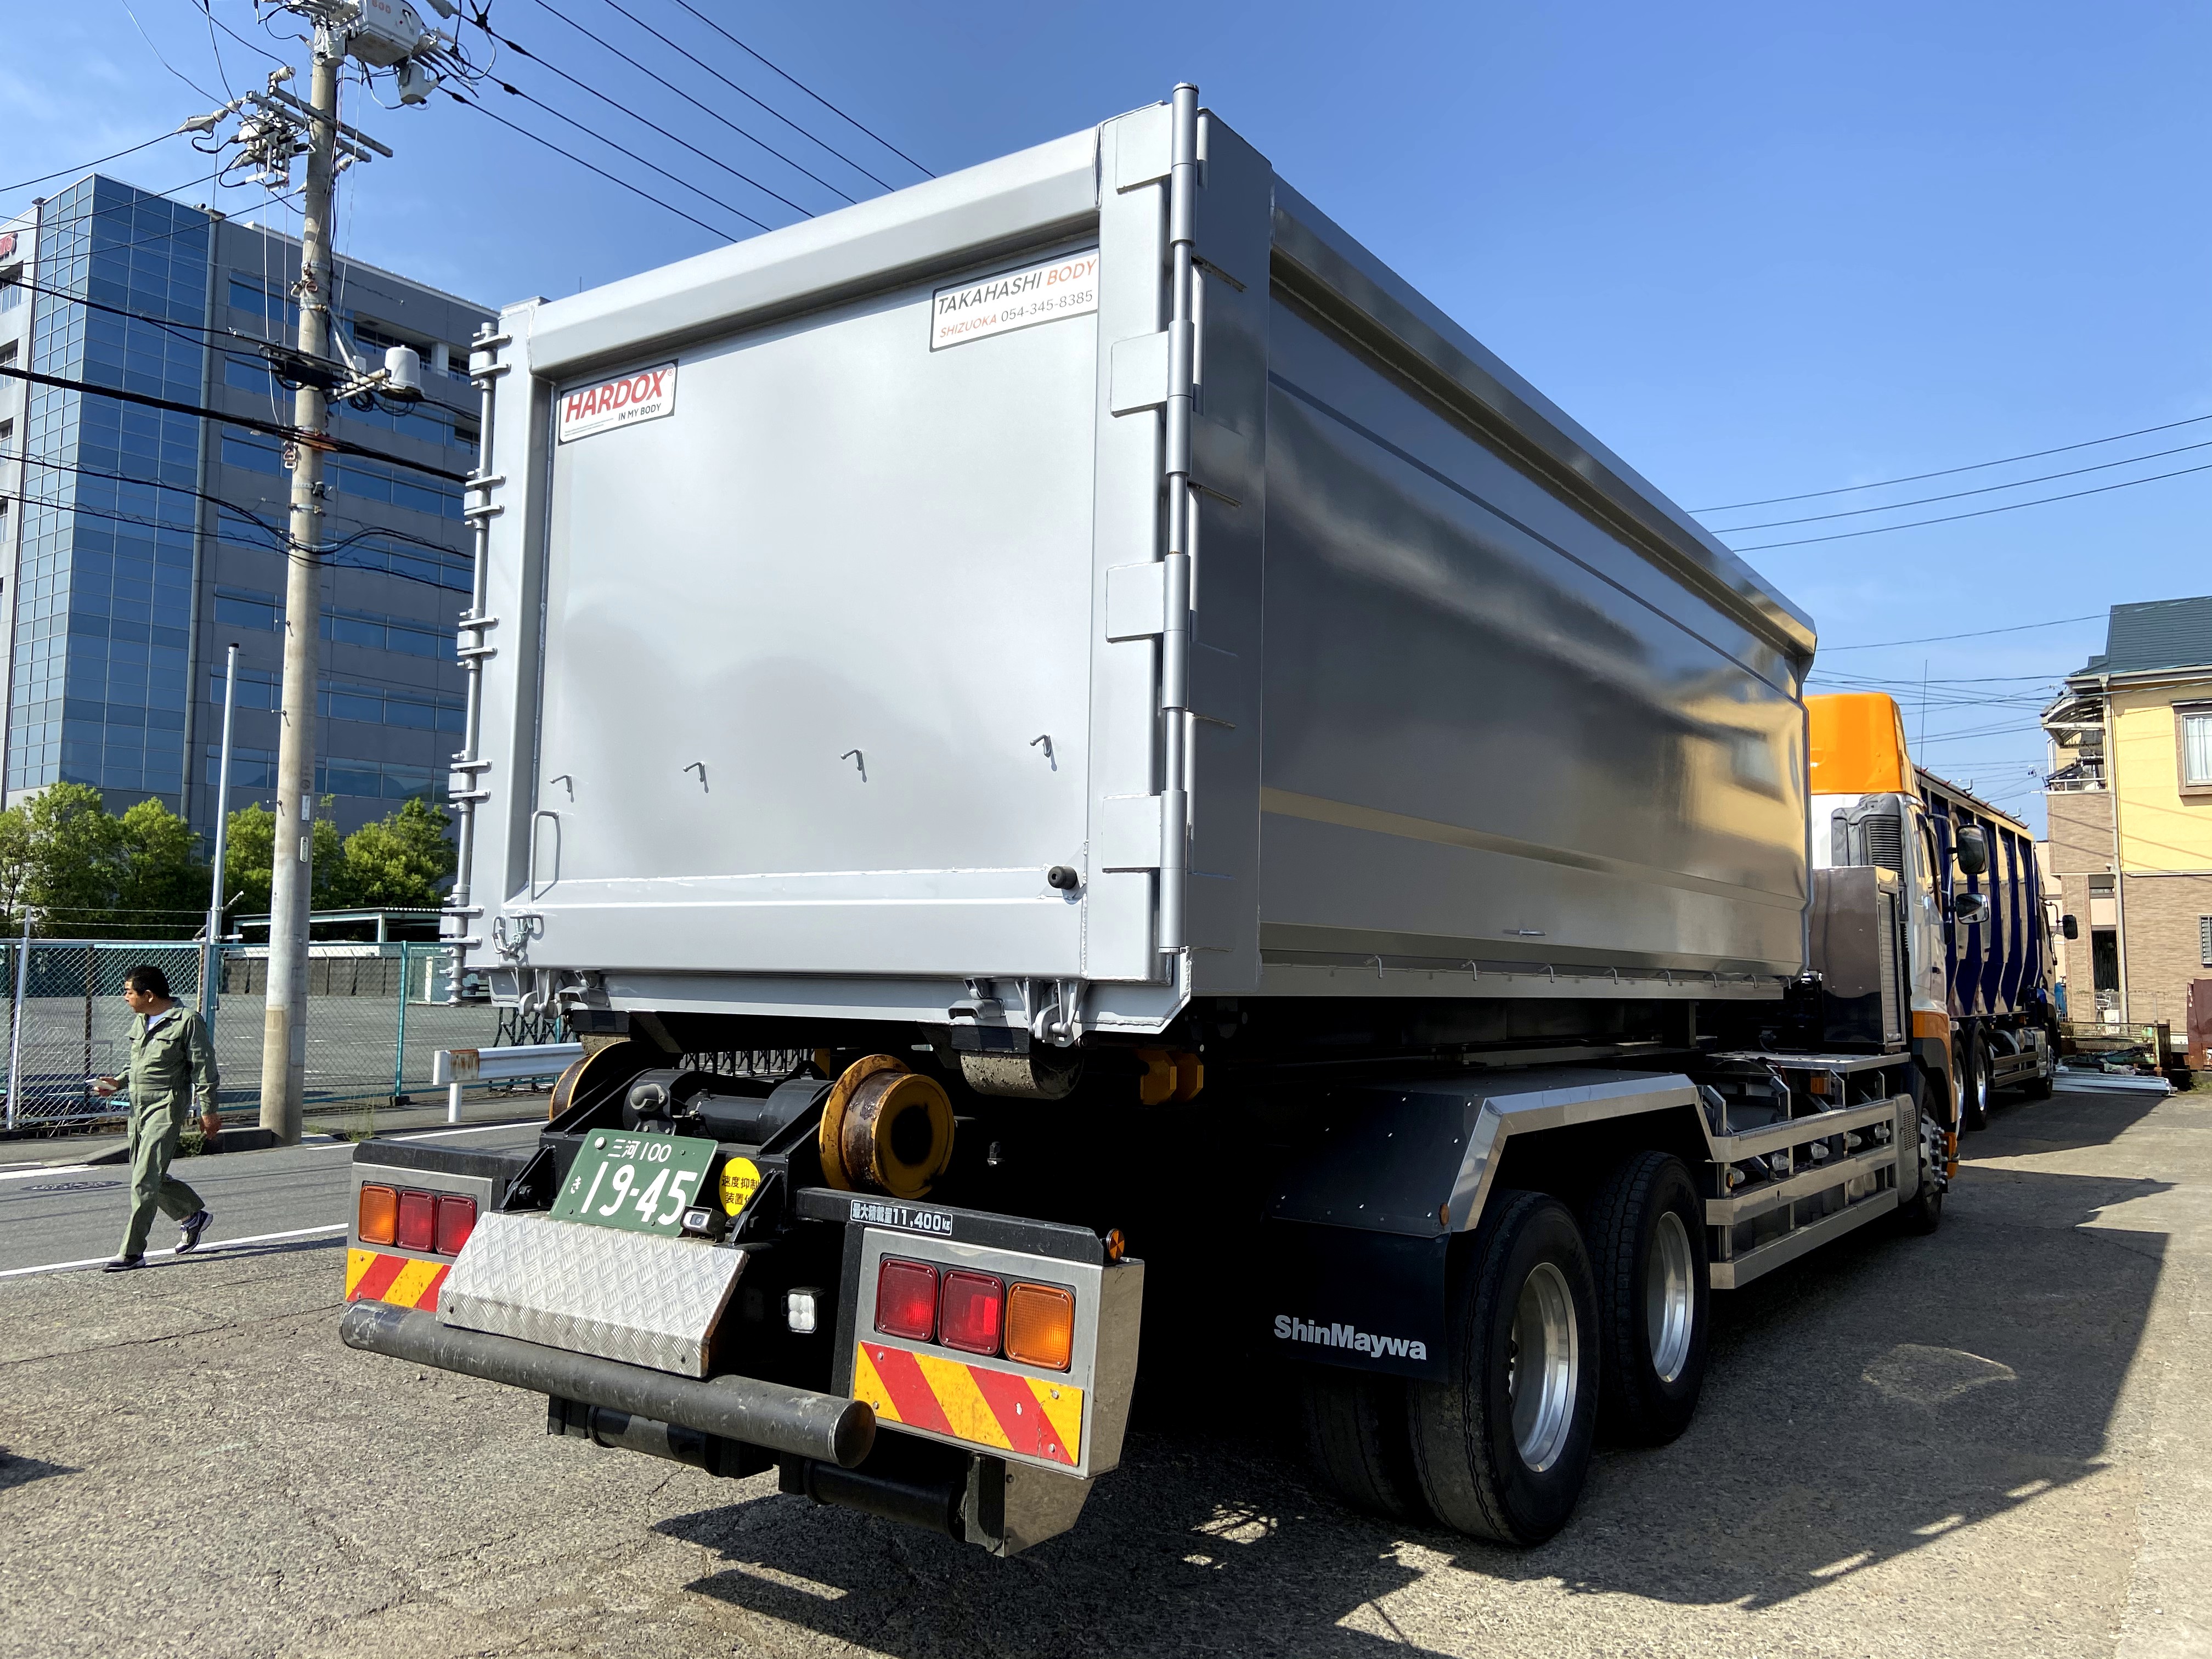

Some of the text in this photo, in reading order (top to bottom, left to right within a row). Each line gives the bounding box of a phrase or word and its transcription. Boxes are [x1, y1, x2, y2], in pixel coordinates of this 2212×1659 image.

[939, 258, 1097, 315] TAKAHASHI BODY
[940, 290, 1093, 338] SHIZUOKA 054-345-8385
[618, 403, 662, 421] IN MY BODY
[571, 1161, 698, 1226] き 19-45
[721, 1175, 760, 1190] 速度抑制
[1274, 1314, 1427, 1361] ShinMaywa
